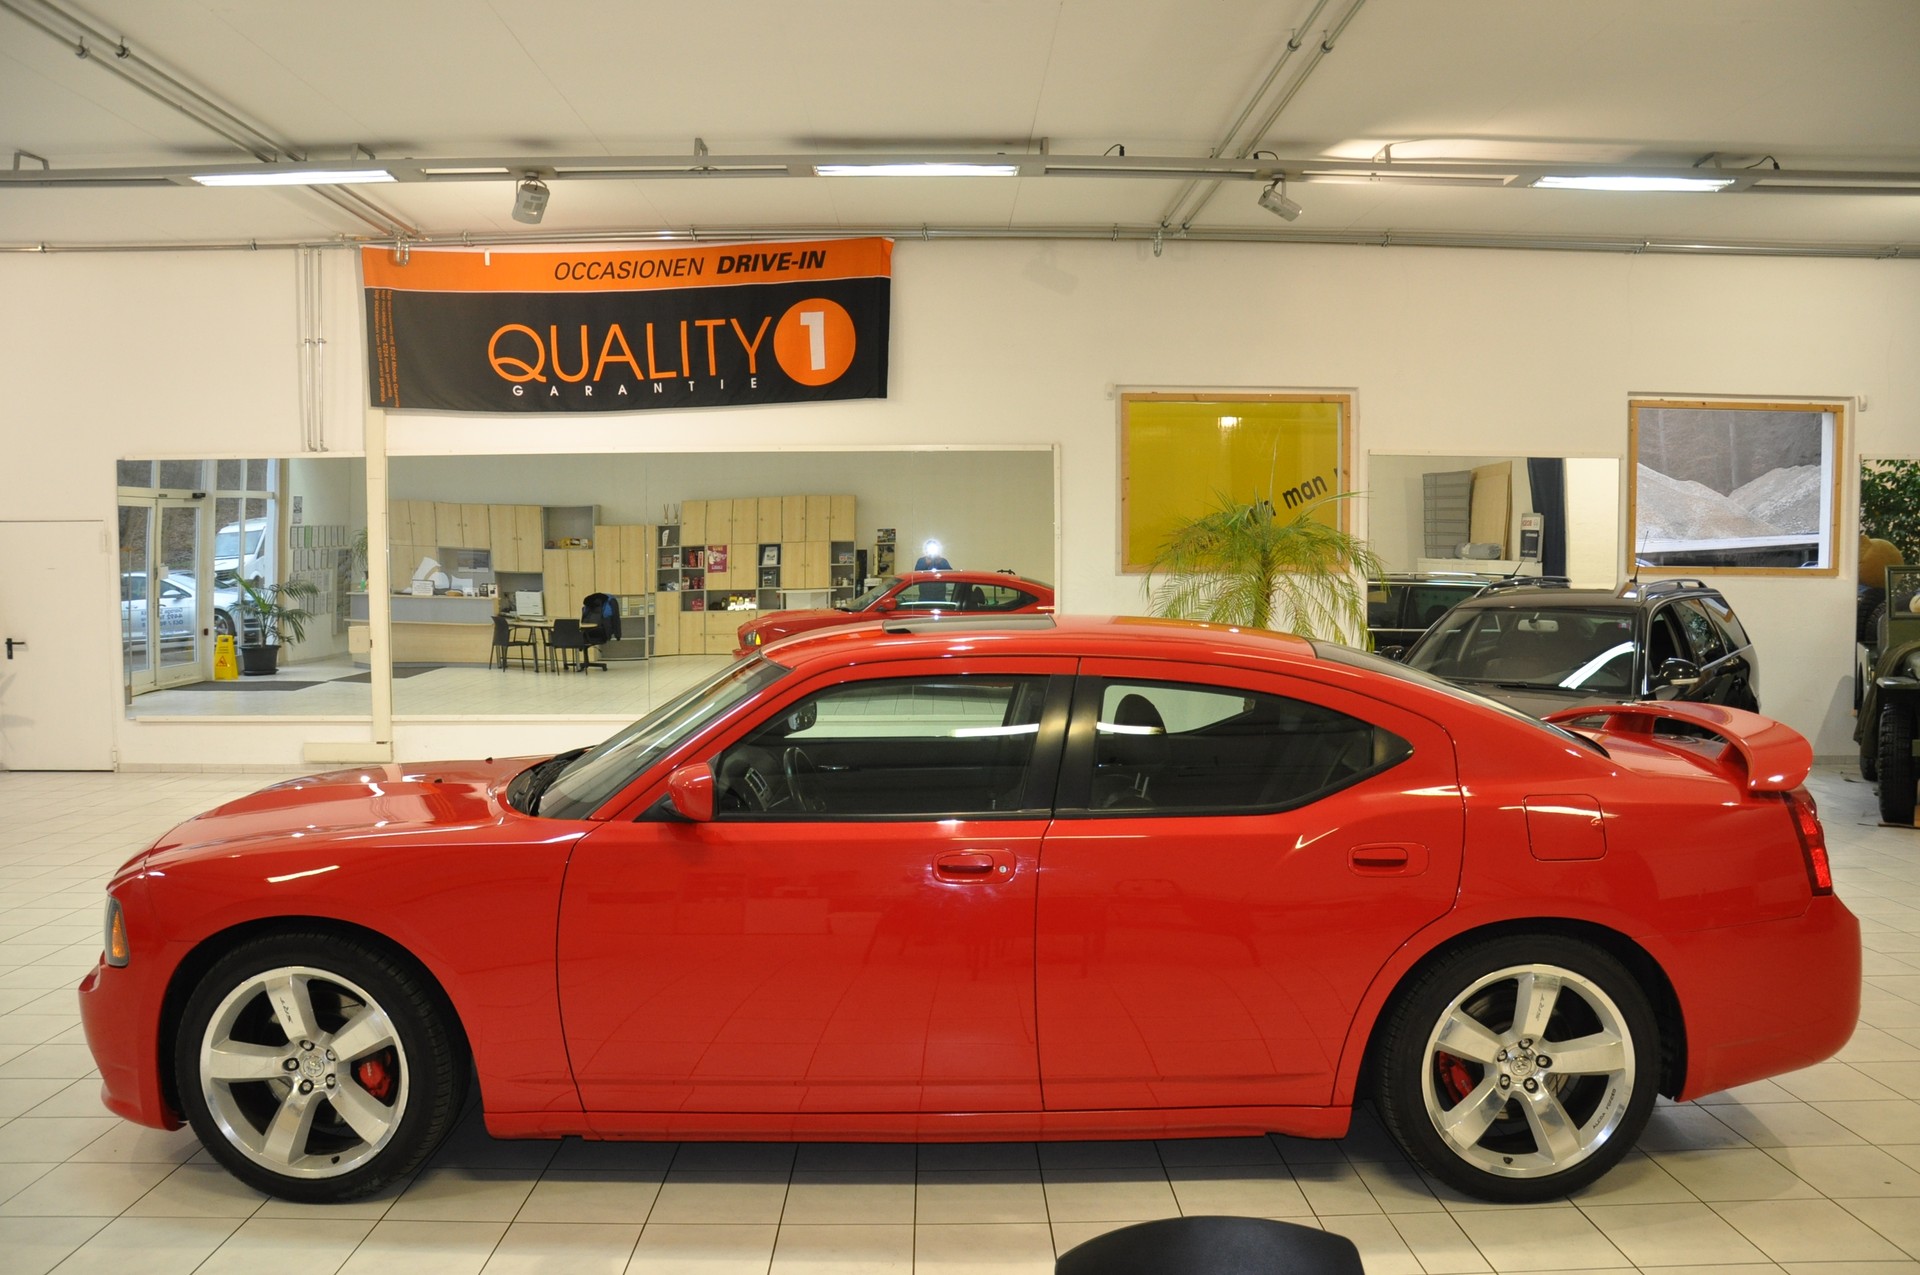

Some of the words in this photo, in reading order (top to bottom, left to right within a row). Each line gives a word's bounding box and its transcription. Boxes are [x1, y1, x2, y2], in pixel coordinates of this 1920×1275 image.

[554, 257, 704, 281] OCCASIONEN
[716, 250, 826, 274] DRIVE-IN
[488, 316, 772, 383] QUALITY
[800, 311, 826, 371] 1
[512, 378, 757, 397] GARANTIE
[1282, 476, 1327, 509] man
